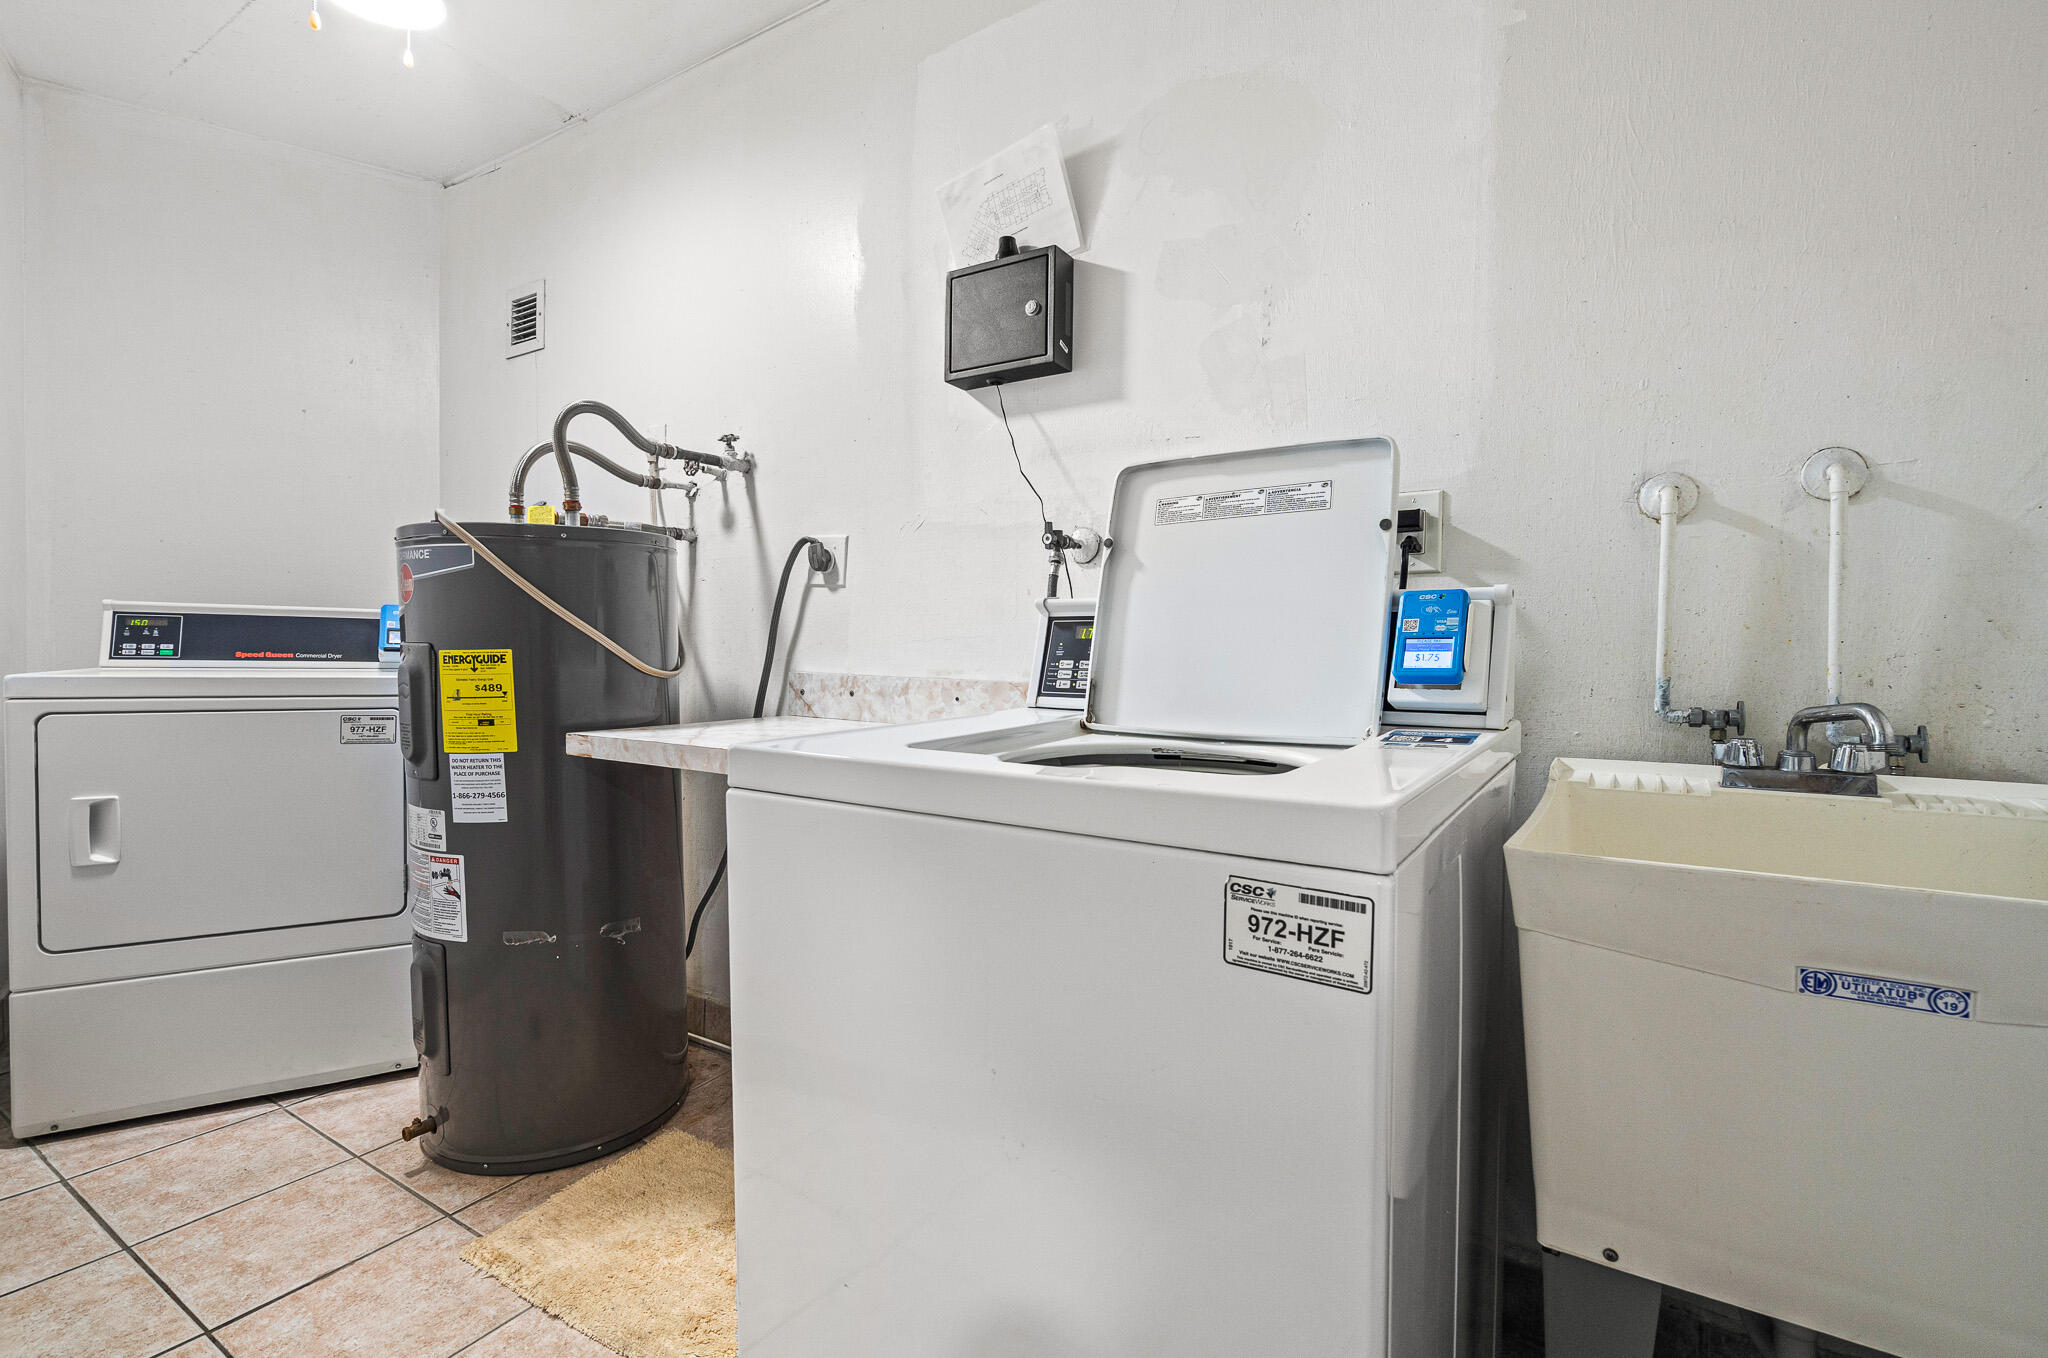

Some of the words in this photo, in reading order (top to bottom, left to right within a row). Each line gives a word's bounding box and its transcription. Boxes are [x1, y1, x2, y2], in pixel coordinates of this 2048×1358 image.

[235, 651, 264, 659] Speed
[442, 654, 507, 665] ENERGYGUIDE
[1415, 653, 1440, 662] $1.75
[474, 683, 503, 693] $489
[452, 791, 506, 799] 1-866-279-4566
[1230, 882, 1265, 897] CSC
[1248, 914, 1346, 949] 972-HZF
[1261, 937, 1282, 945] Service:
[1258, 954, 1275, 962] website
[1268, 945, 1324, 963] 1-877-264-6622
[1936, 992, 1964, 1004] MODEL
[1942, 1001, 1958, 1011] 19
